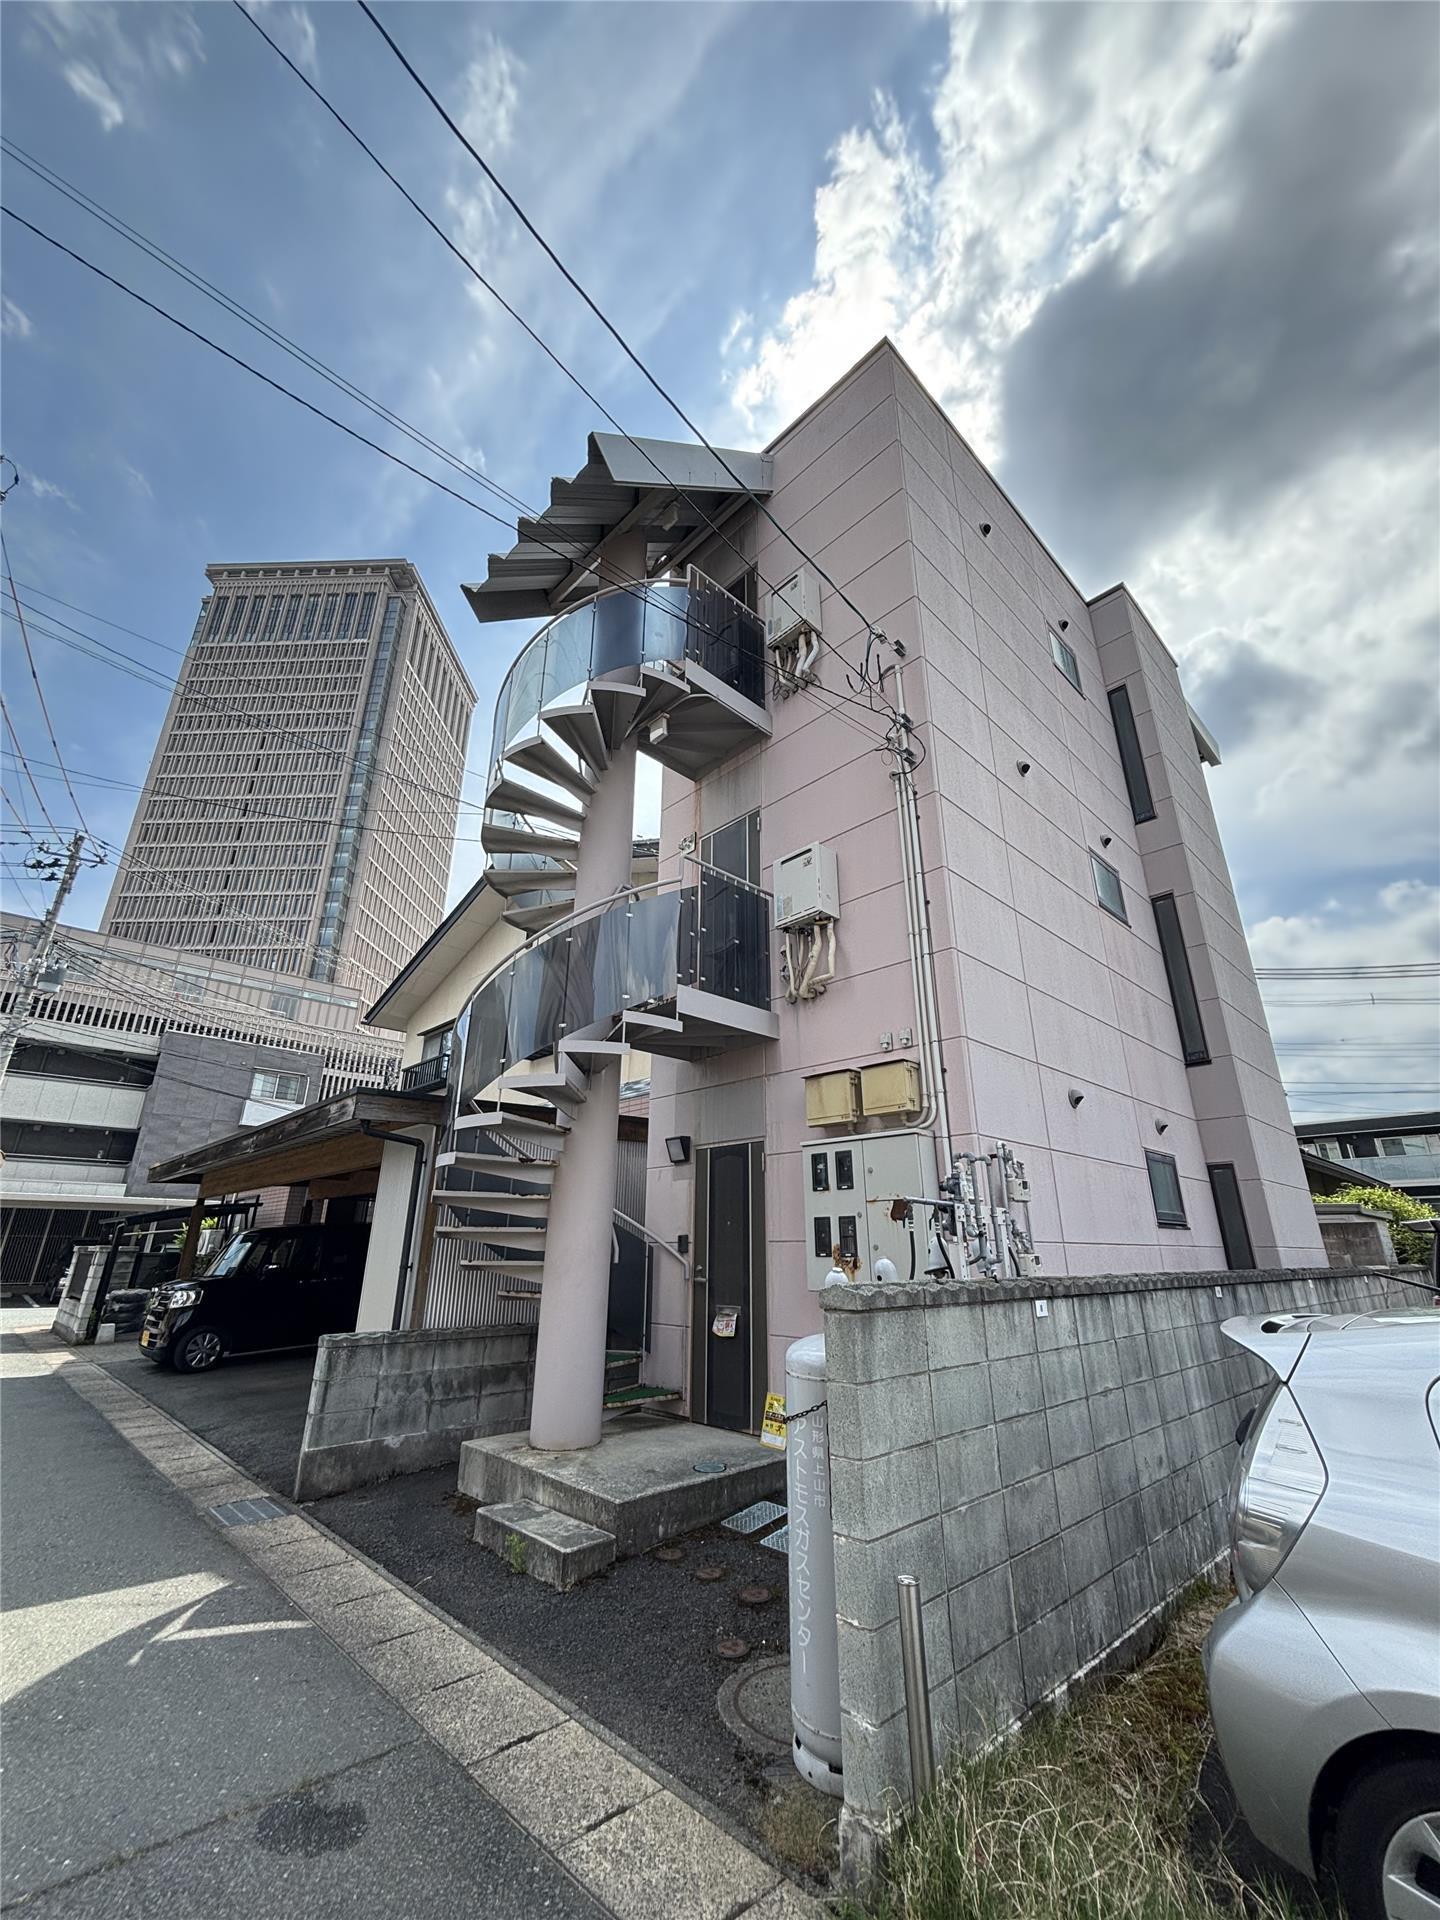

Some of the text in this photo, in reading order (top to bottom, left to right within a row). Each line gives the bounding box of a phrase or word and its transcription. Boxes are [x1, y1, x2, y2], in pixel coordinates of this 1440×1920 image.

[794, 1417, 811, 1674] アストモスガスセンター
[811, 1414, 827, 1508] 山形県上山市
